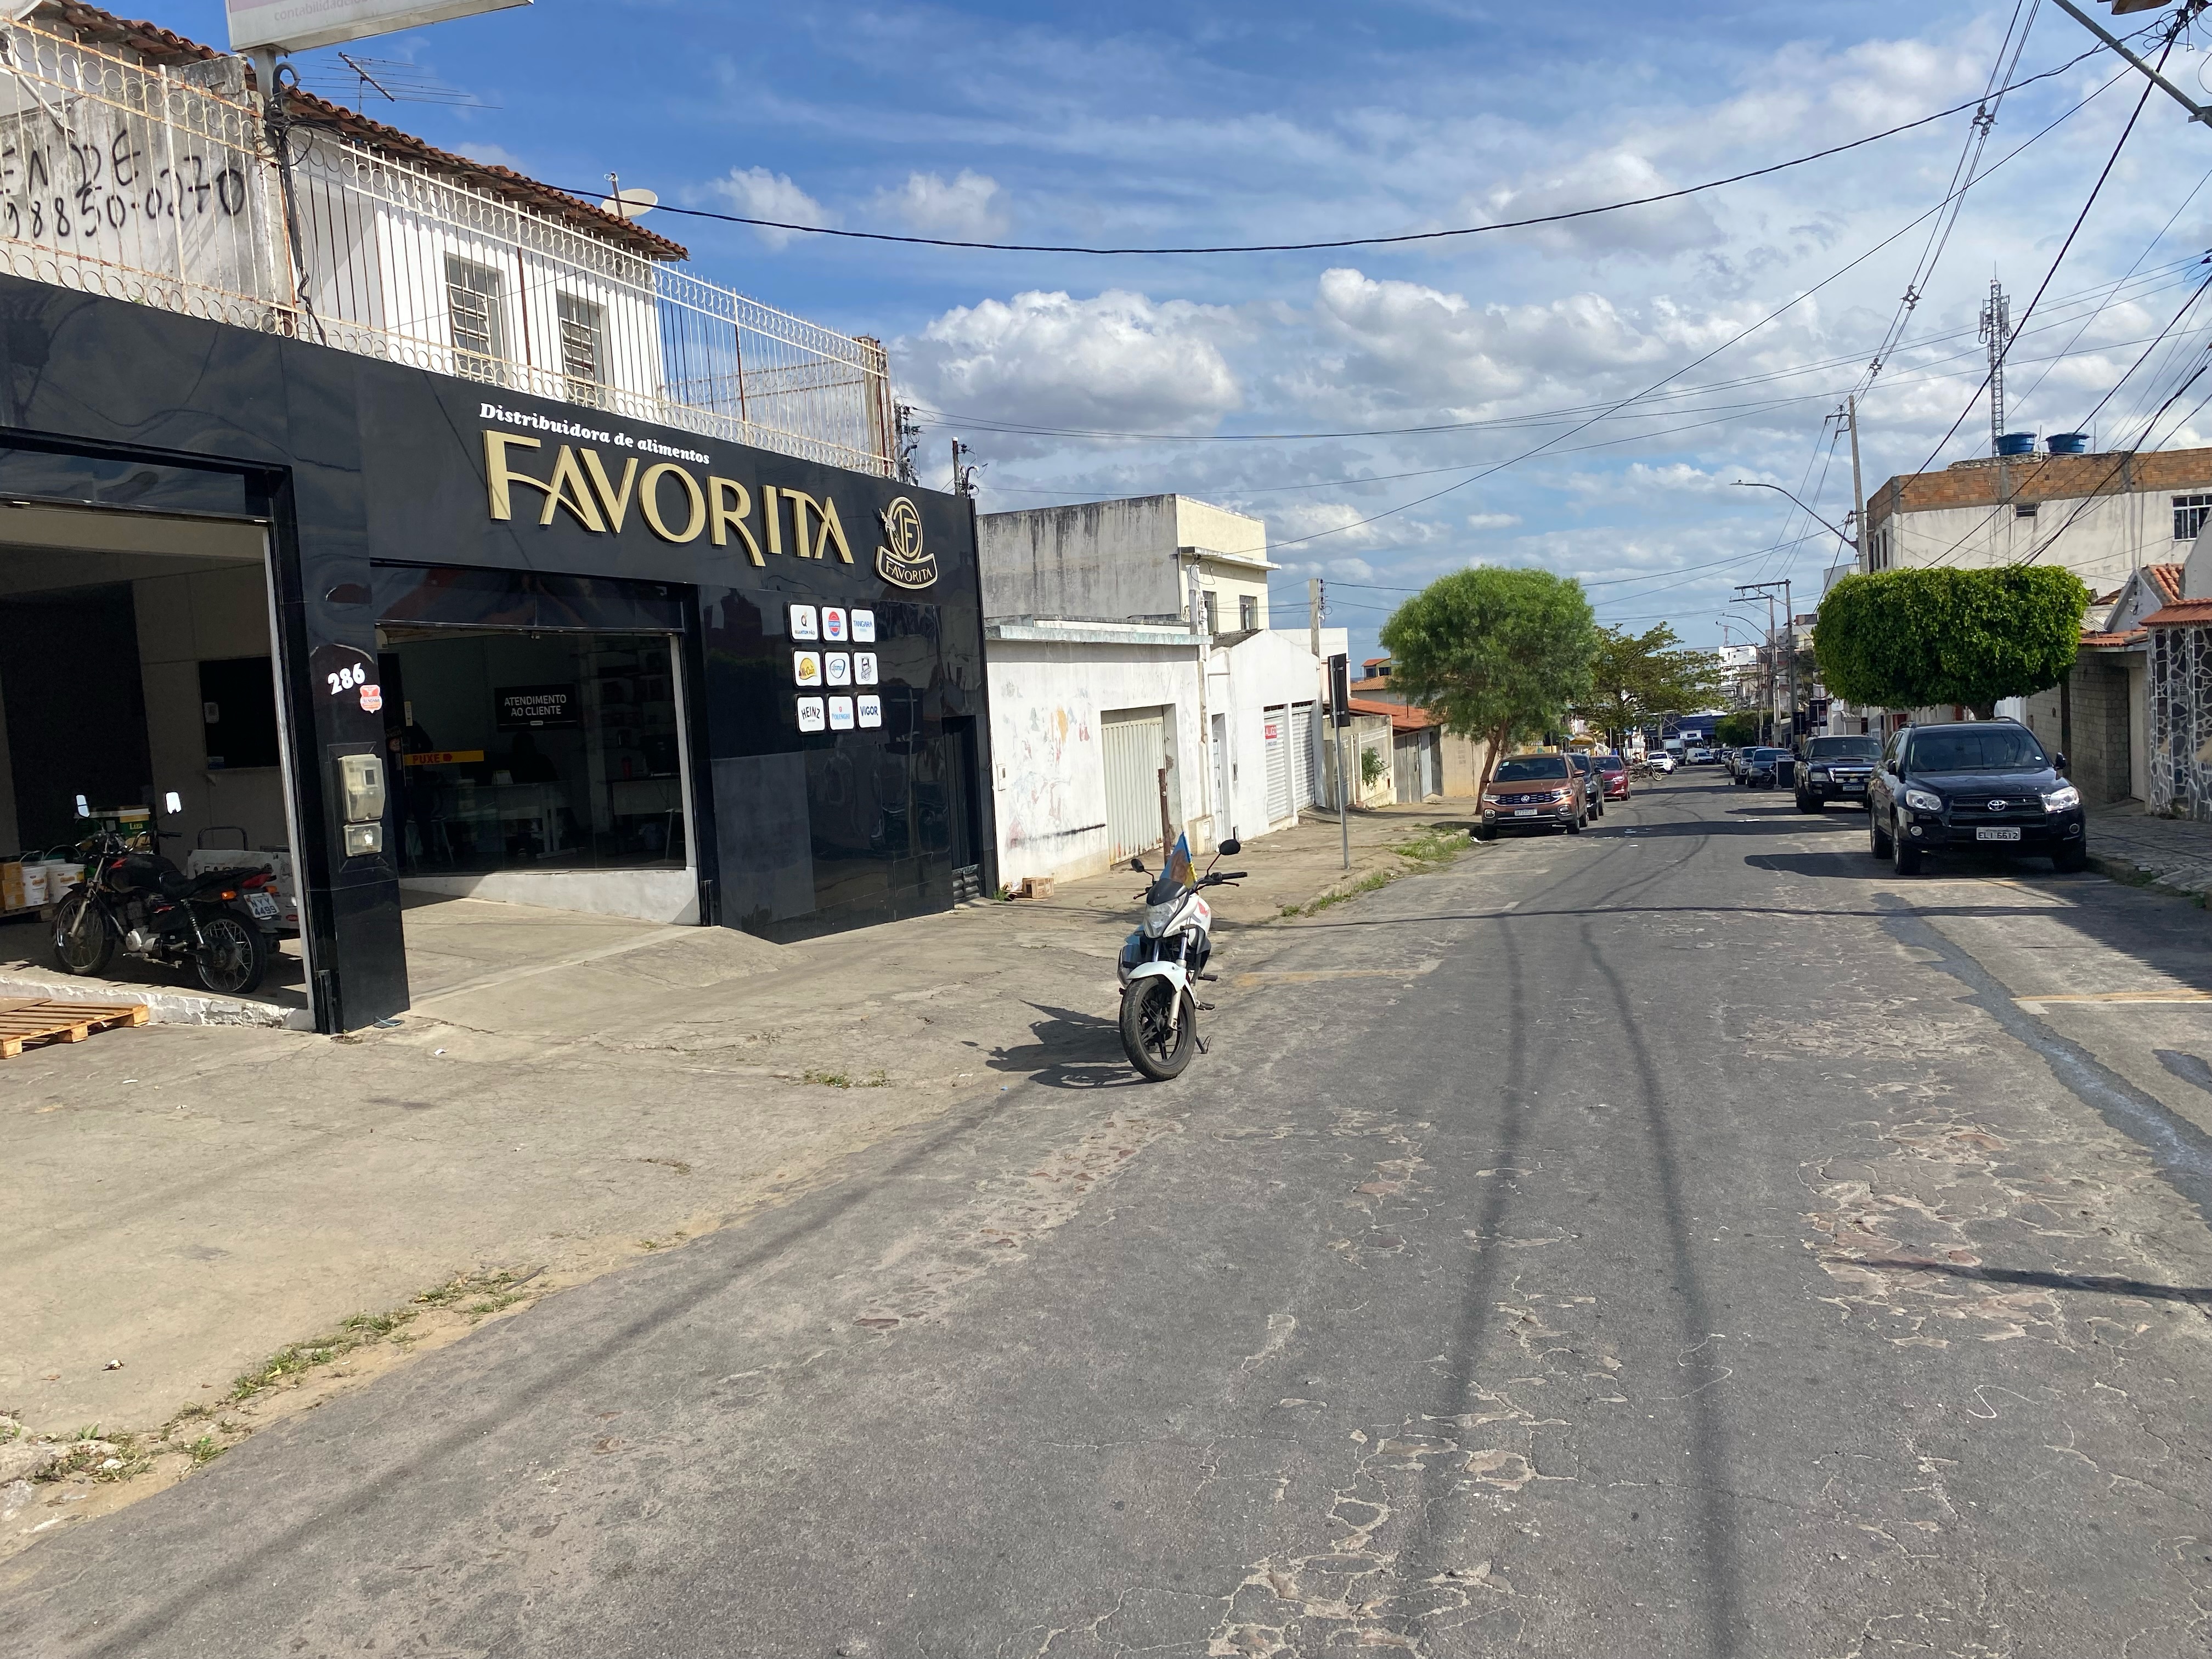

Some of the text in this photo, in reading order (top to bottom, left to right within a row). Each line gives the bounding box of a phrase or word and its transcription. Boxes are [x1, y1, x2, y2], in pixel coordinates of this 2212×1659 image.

[274, 0, 368, 21] contabilidade
[479, 403, 710, 465] Distribuidora de alimentos
[483, 430, 854, 567] FAVORITA
[886, 560, 933, 583] FAVORITA
[328, 662, 365, 695] 286
[505, 695, 566, 706] ATENDIMENTO
[511, 706, 561, 716] AO CLIENTE
[801, 706, 820, 720] HEINZ
[860, 706, 878, 716] VIGOR
[1266, 726, 1277, 736] ALUGO
[413, 754, 441, 764] PUXE
[250, 898, 270, 908] NYY
[255, 906, 276, 916] 4499
